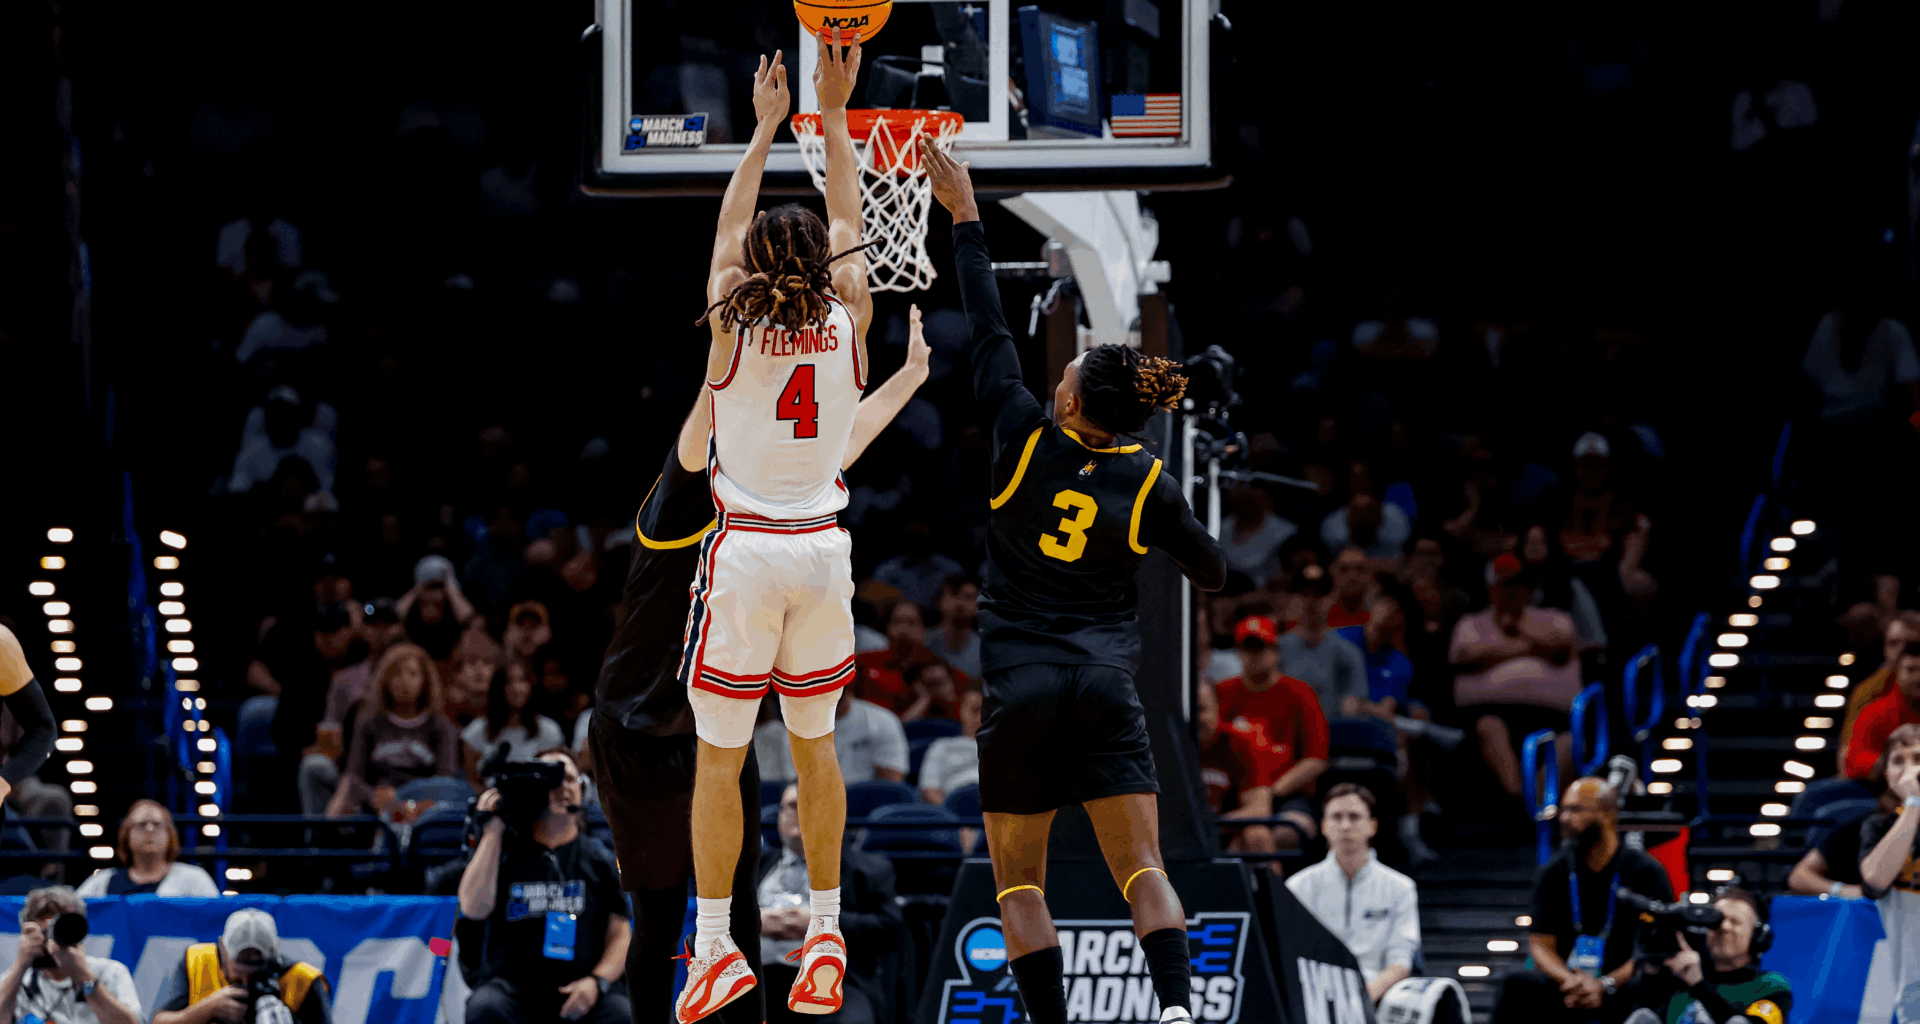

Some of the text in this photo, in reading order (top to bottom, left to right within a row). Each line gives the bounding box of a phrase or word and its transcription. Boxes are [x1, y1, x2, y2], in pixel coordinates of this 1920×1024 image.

[822, 14, 869, 29] NCAA
[641, 117, 686, 132] MARCH
[760, 324, 838, 356] FLEMINGS
[776, 363, 819, 439] 4
[1038, 488, 1099, 563] 3
